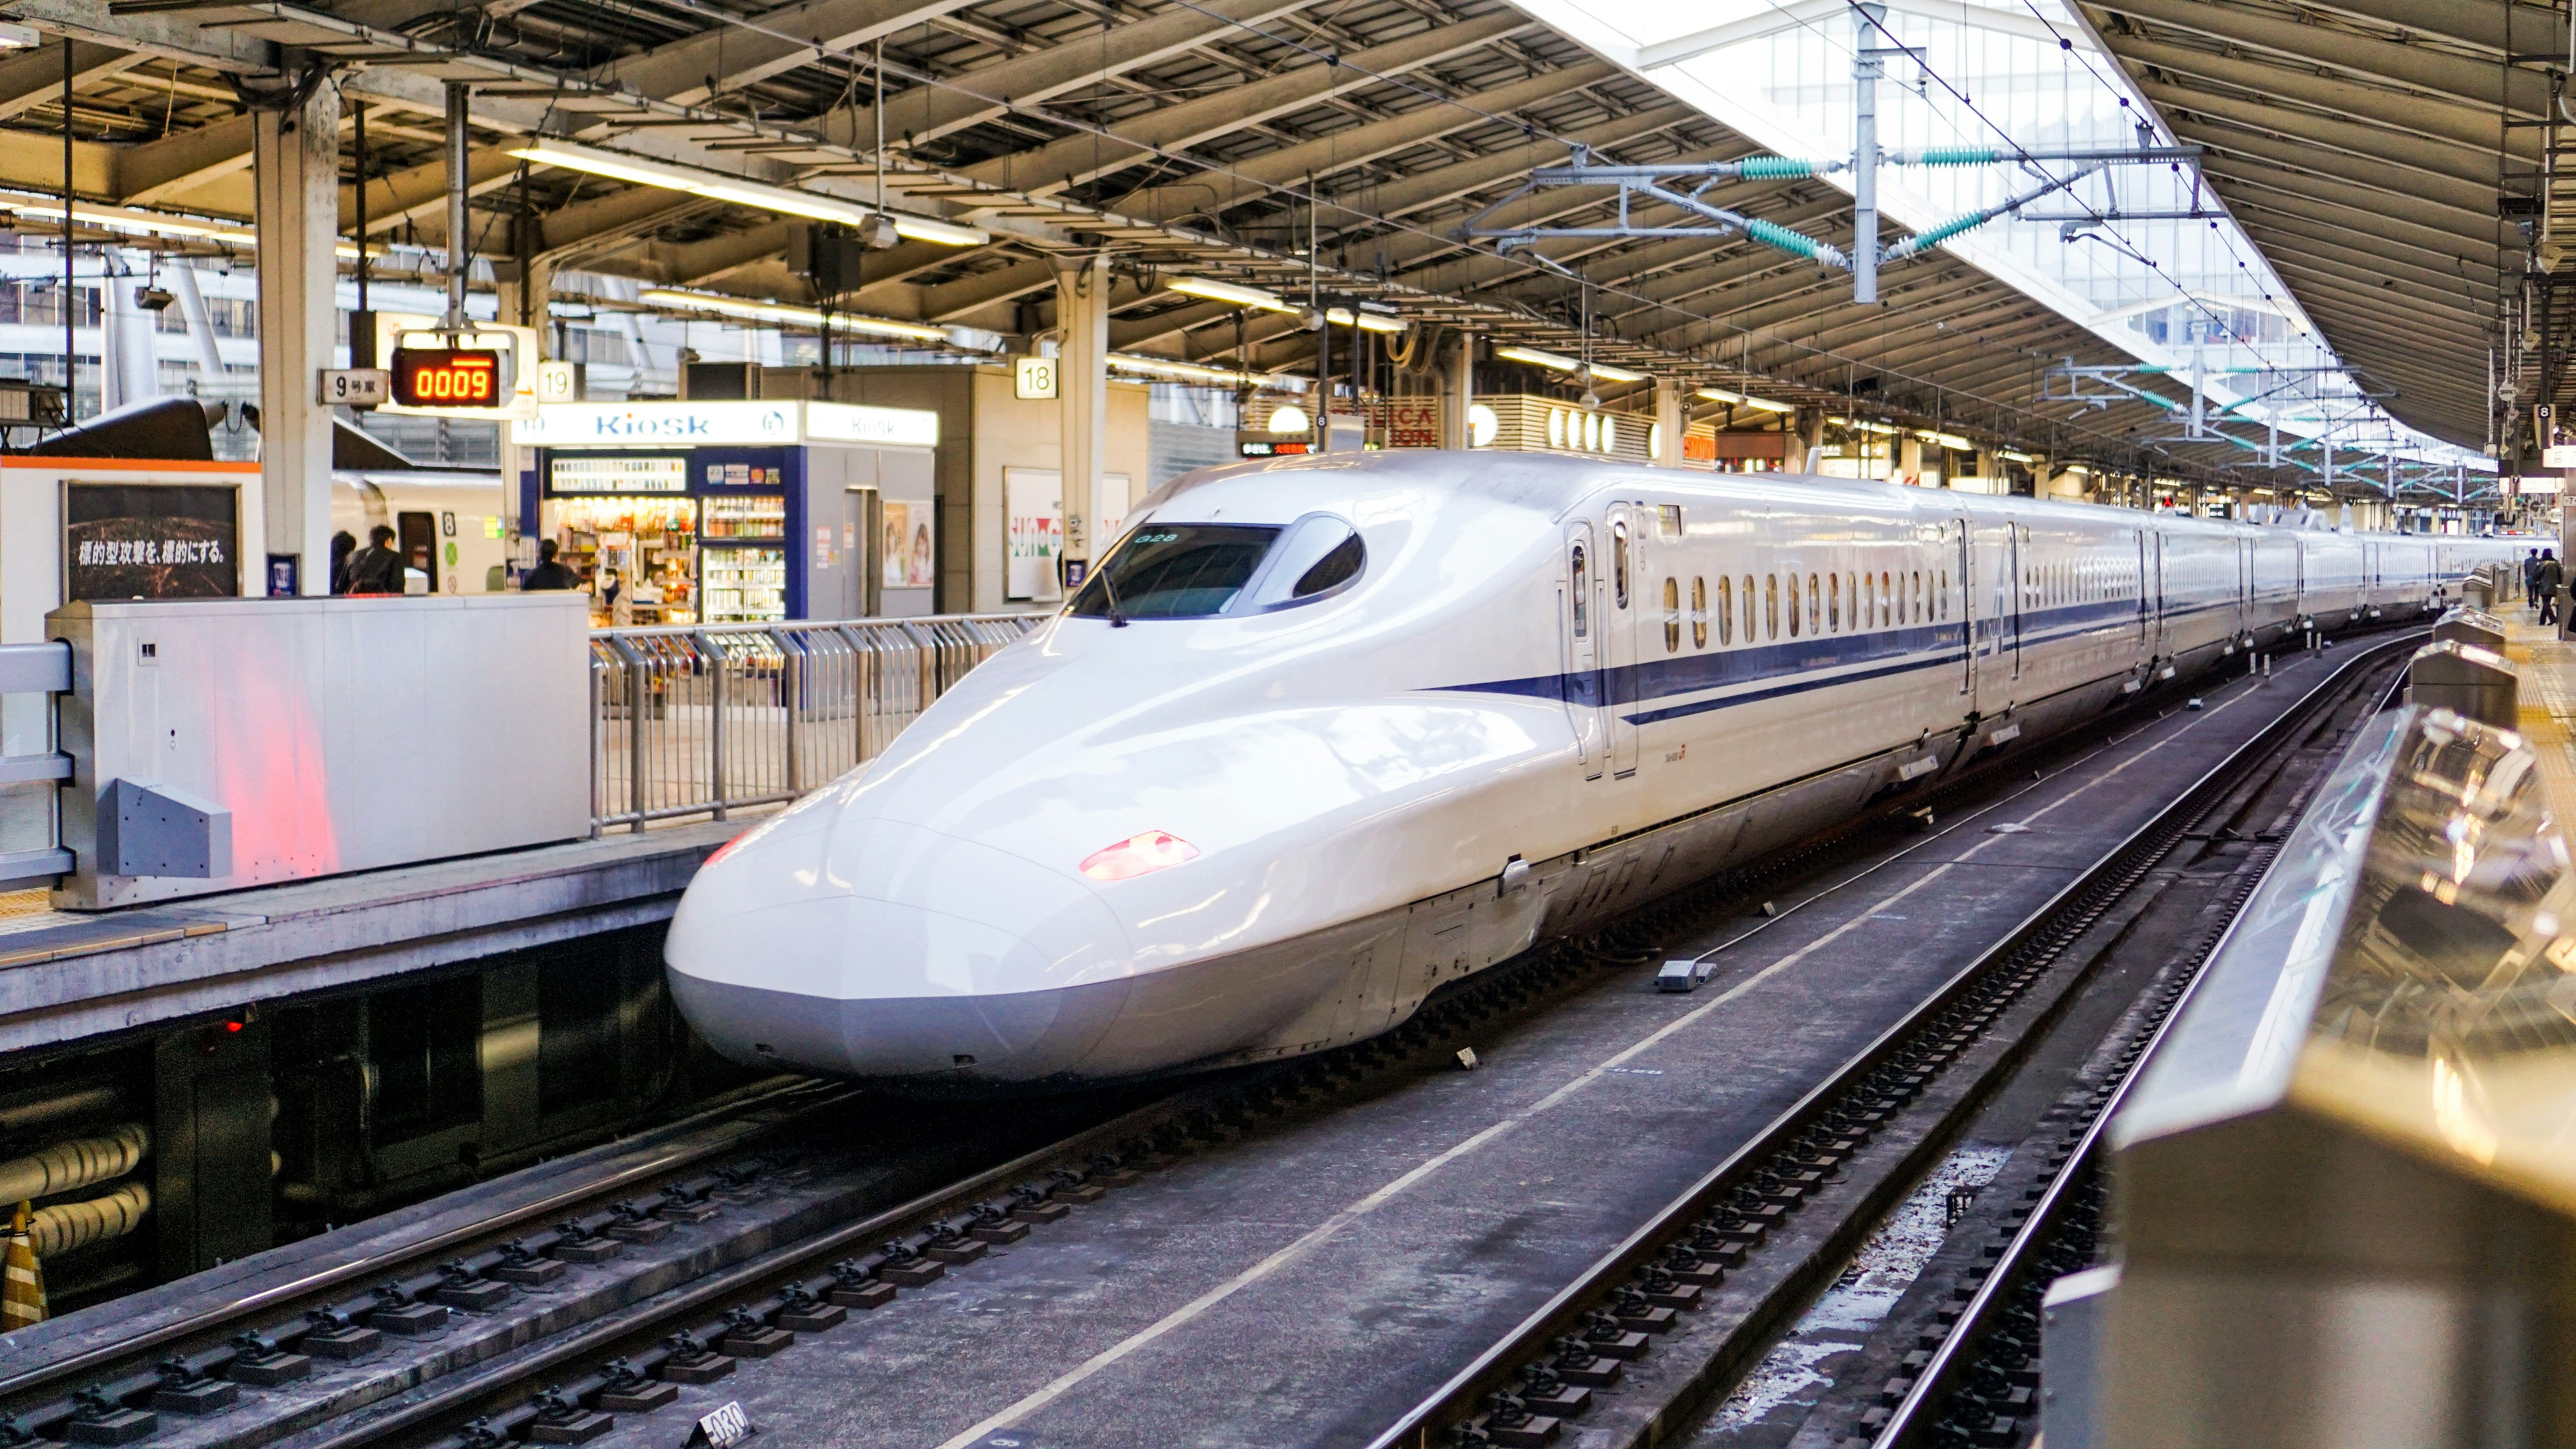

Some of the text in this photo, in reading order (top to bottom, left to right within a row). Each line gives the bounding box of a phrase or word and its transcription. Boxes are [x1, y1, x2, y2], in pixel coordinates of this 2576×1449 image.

[337, 376, 375, 397] 9号車
[416, 369, 488, 398] 0009
[544, 372, 567, 394] 19
[1025, 367, 1049, 390] 18
[1318, 417, 1325, 426] 8
[2540, 407, 2549, 417] 8
[596, 412, 709, 436] Kiosk
[445, 514, 454, 535] 8
[79, 539, 223, 566] 標的型攻撃を、標的にする。
